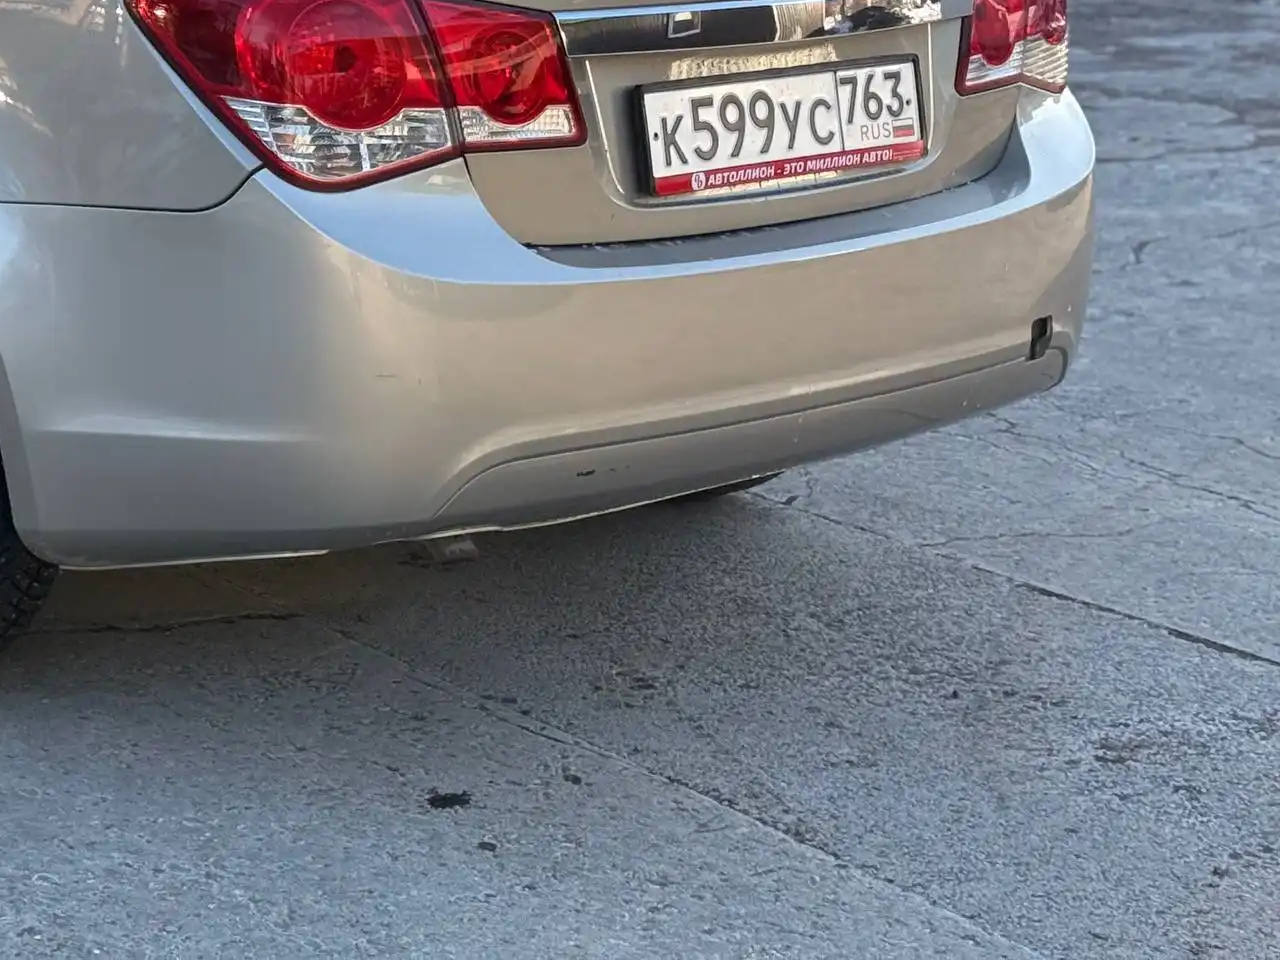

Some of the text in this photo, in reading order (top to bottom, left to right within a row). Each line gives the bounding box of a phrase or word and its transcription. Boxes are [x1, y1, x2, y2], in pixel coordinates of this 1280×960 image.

[661, 70, 904, 167] К599УС 763
[860, 122, 892, 142] RUS
[707, 166, 775, 186] АВТОЛЛИОН
[783, 161, 805, 175] ЭТО
[806, 151, 861, 172] МИЛЛИОН
[862, 148, 893, 163] АВТО!
